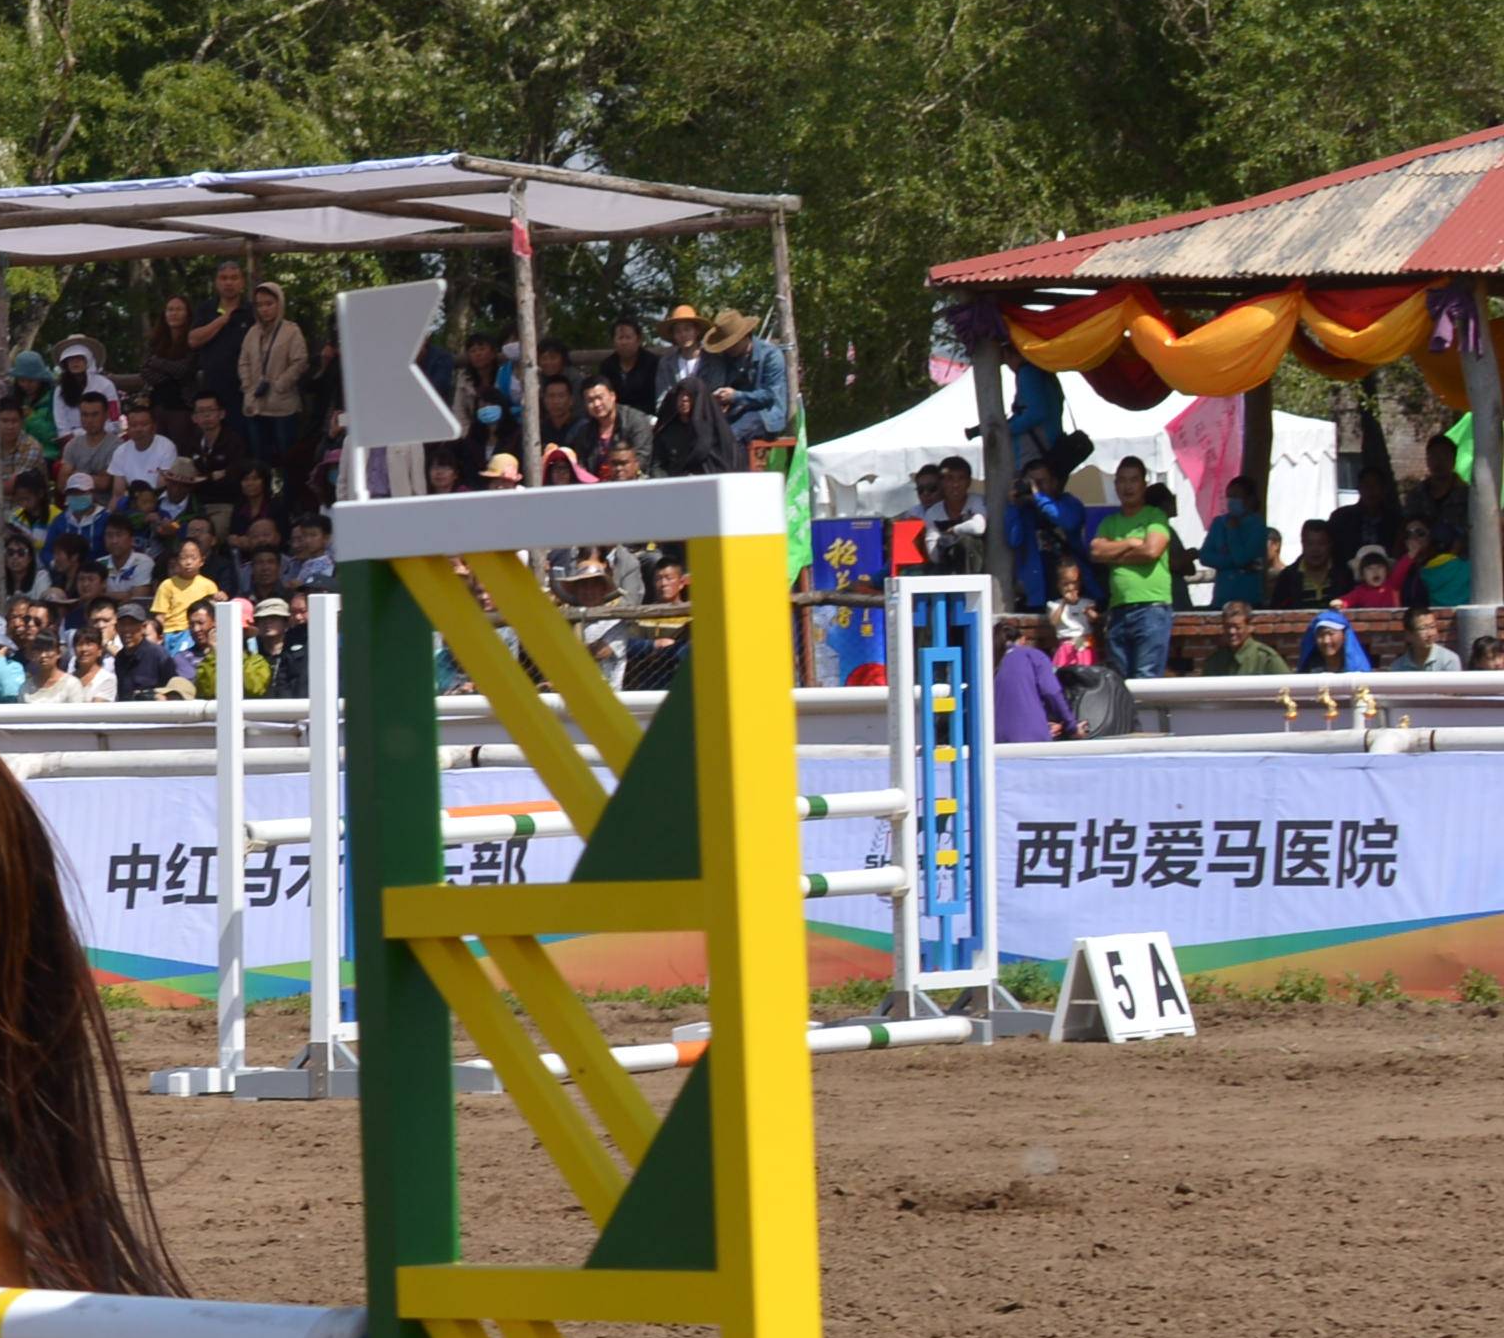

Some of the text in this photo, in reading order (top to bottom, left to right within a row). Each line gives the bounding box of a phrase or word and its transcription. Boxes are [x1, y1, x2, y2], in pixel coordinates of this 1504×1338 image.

[1015, 817, 1399, 889] 西坞爱马医院
